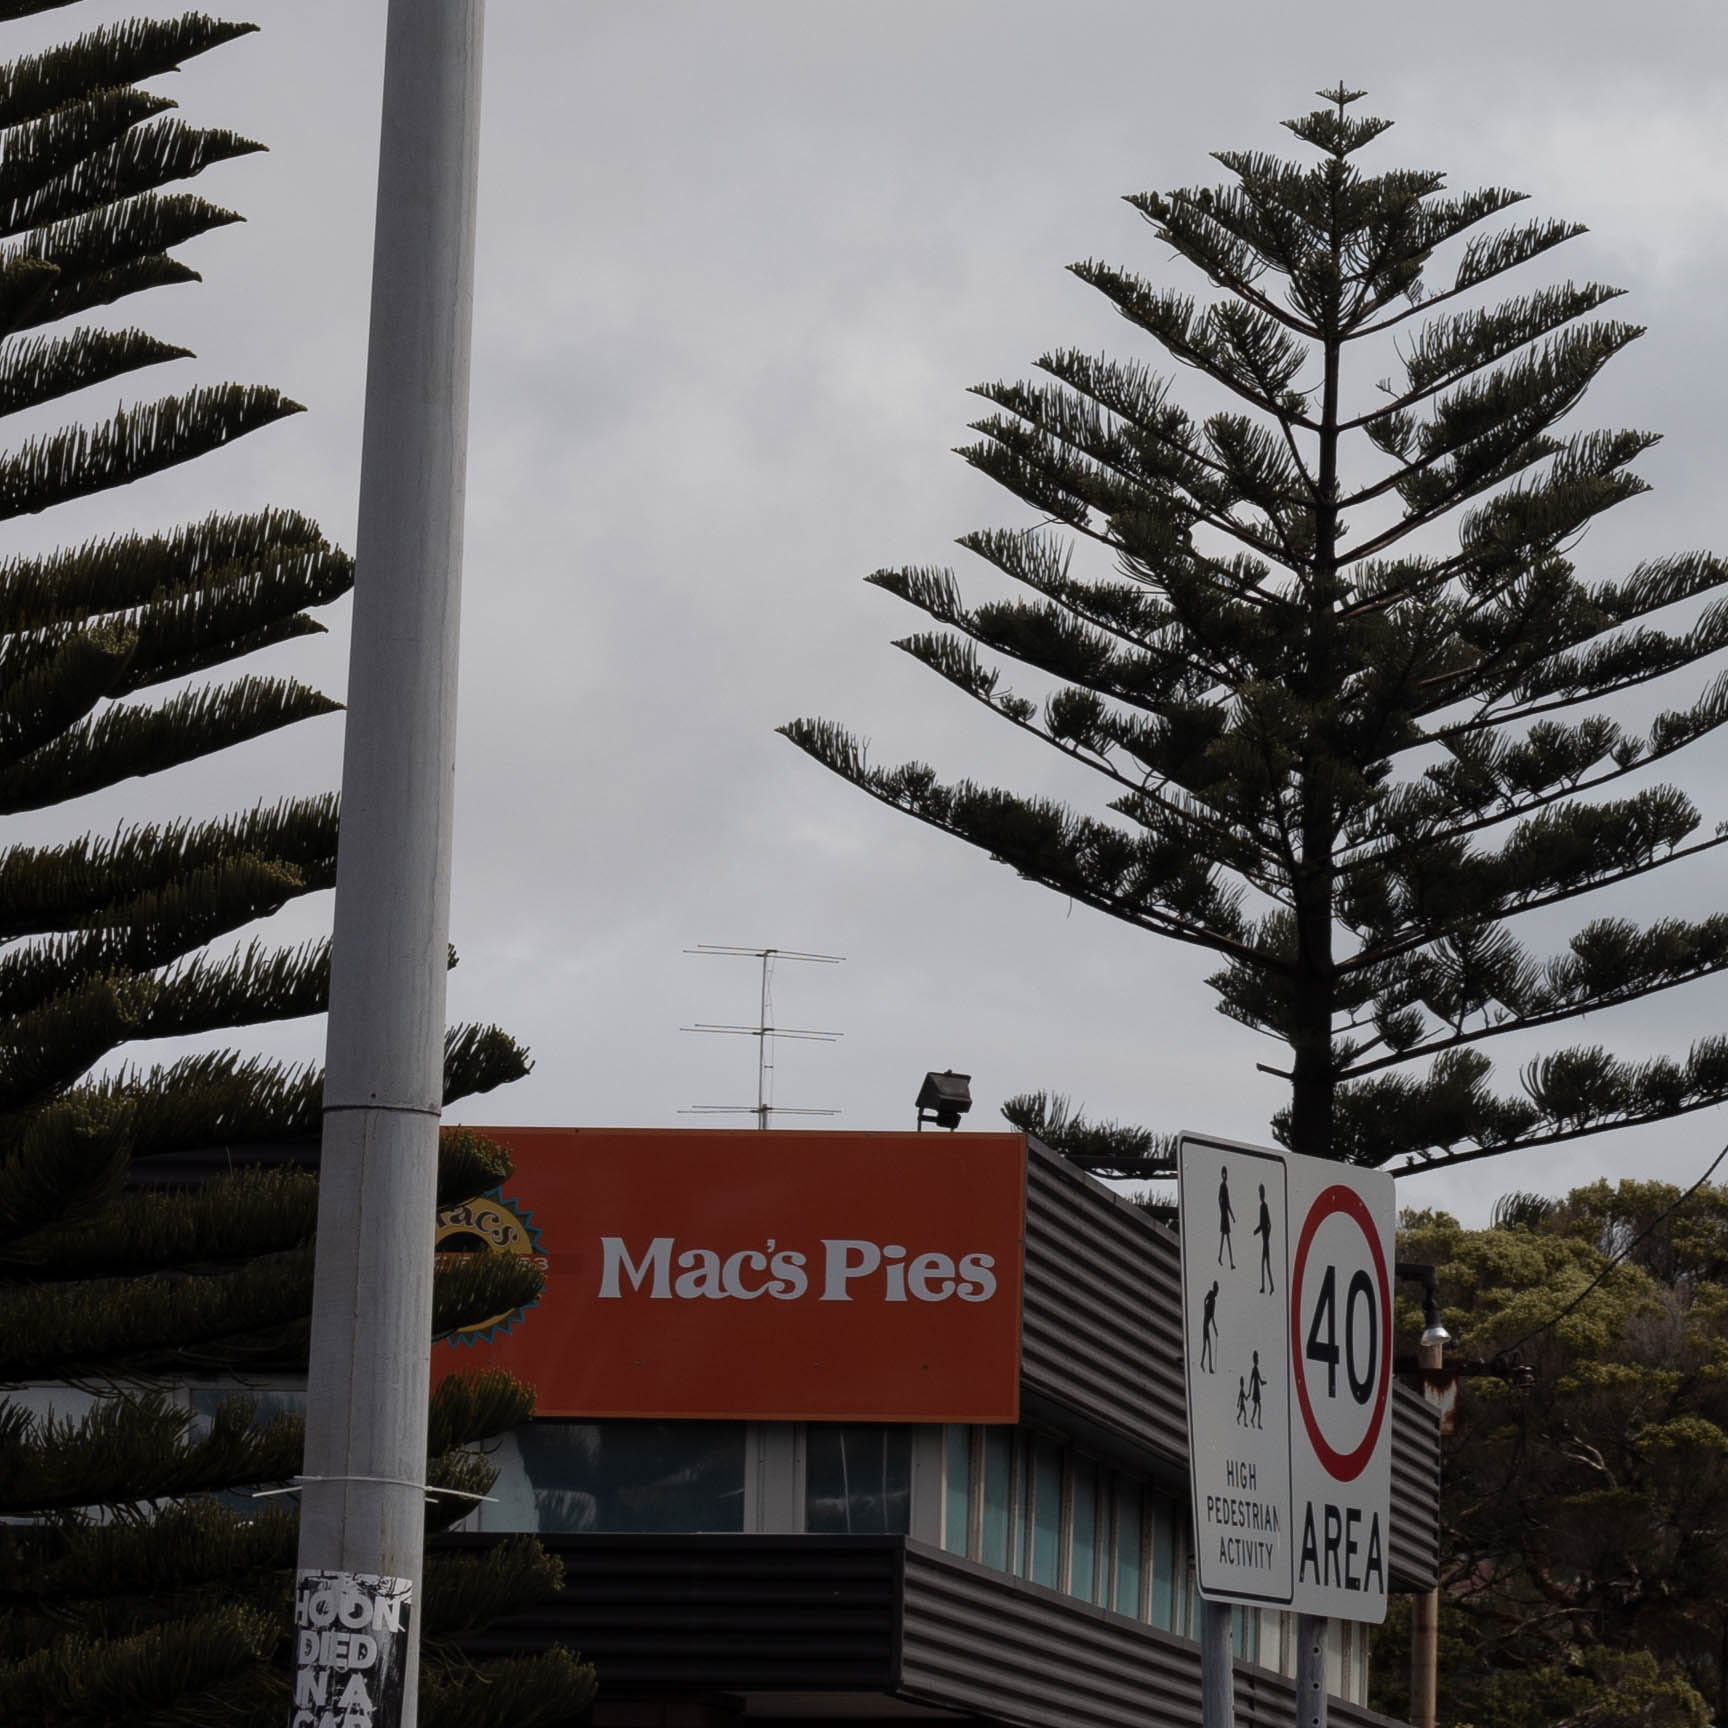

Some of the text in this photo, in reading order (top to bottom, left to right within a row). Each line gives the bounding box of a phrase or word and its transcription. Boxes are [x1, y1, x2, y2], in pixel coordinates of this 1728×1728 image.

[598, 1236, 998, 1303] Mac's Pies
[1306, 1265, 1377, 1405] 40
[1225, 1459, 1257, 1491] HIGH
[1206, 1495, 1281, 1533] PEDESTRIAN
[1219, 1536, 1273, 1571] ACTIVITY
[1298, 1500, 1384, 1595] AREA
[298, 1630, 378, 1672] DIED
